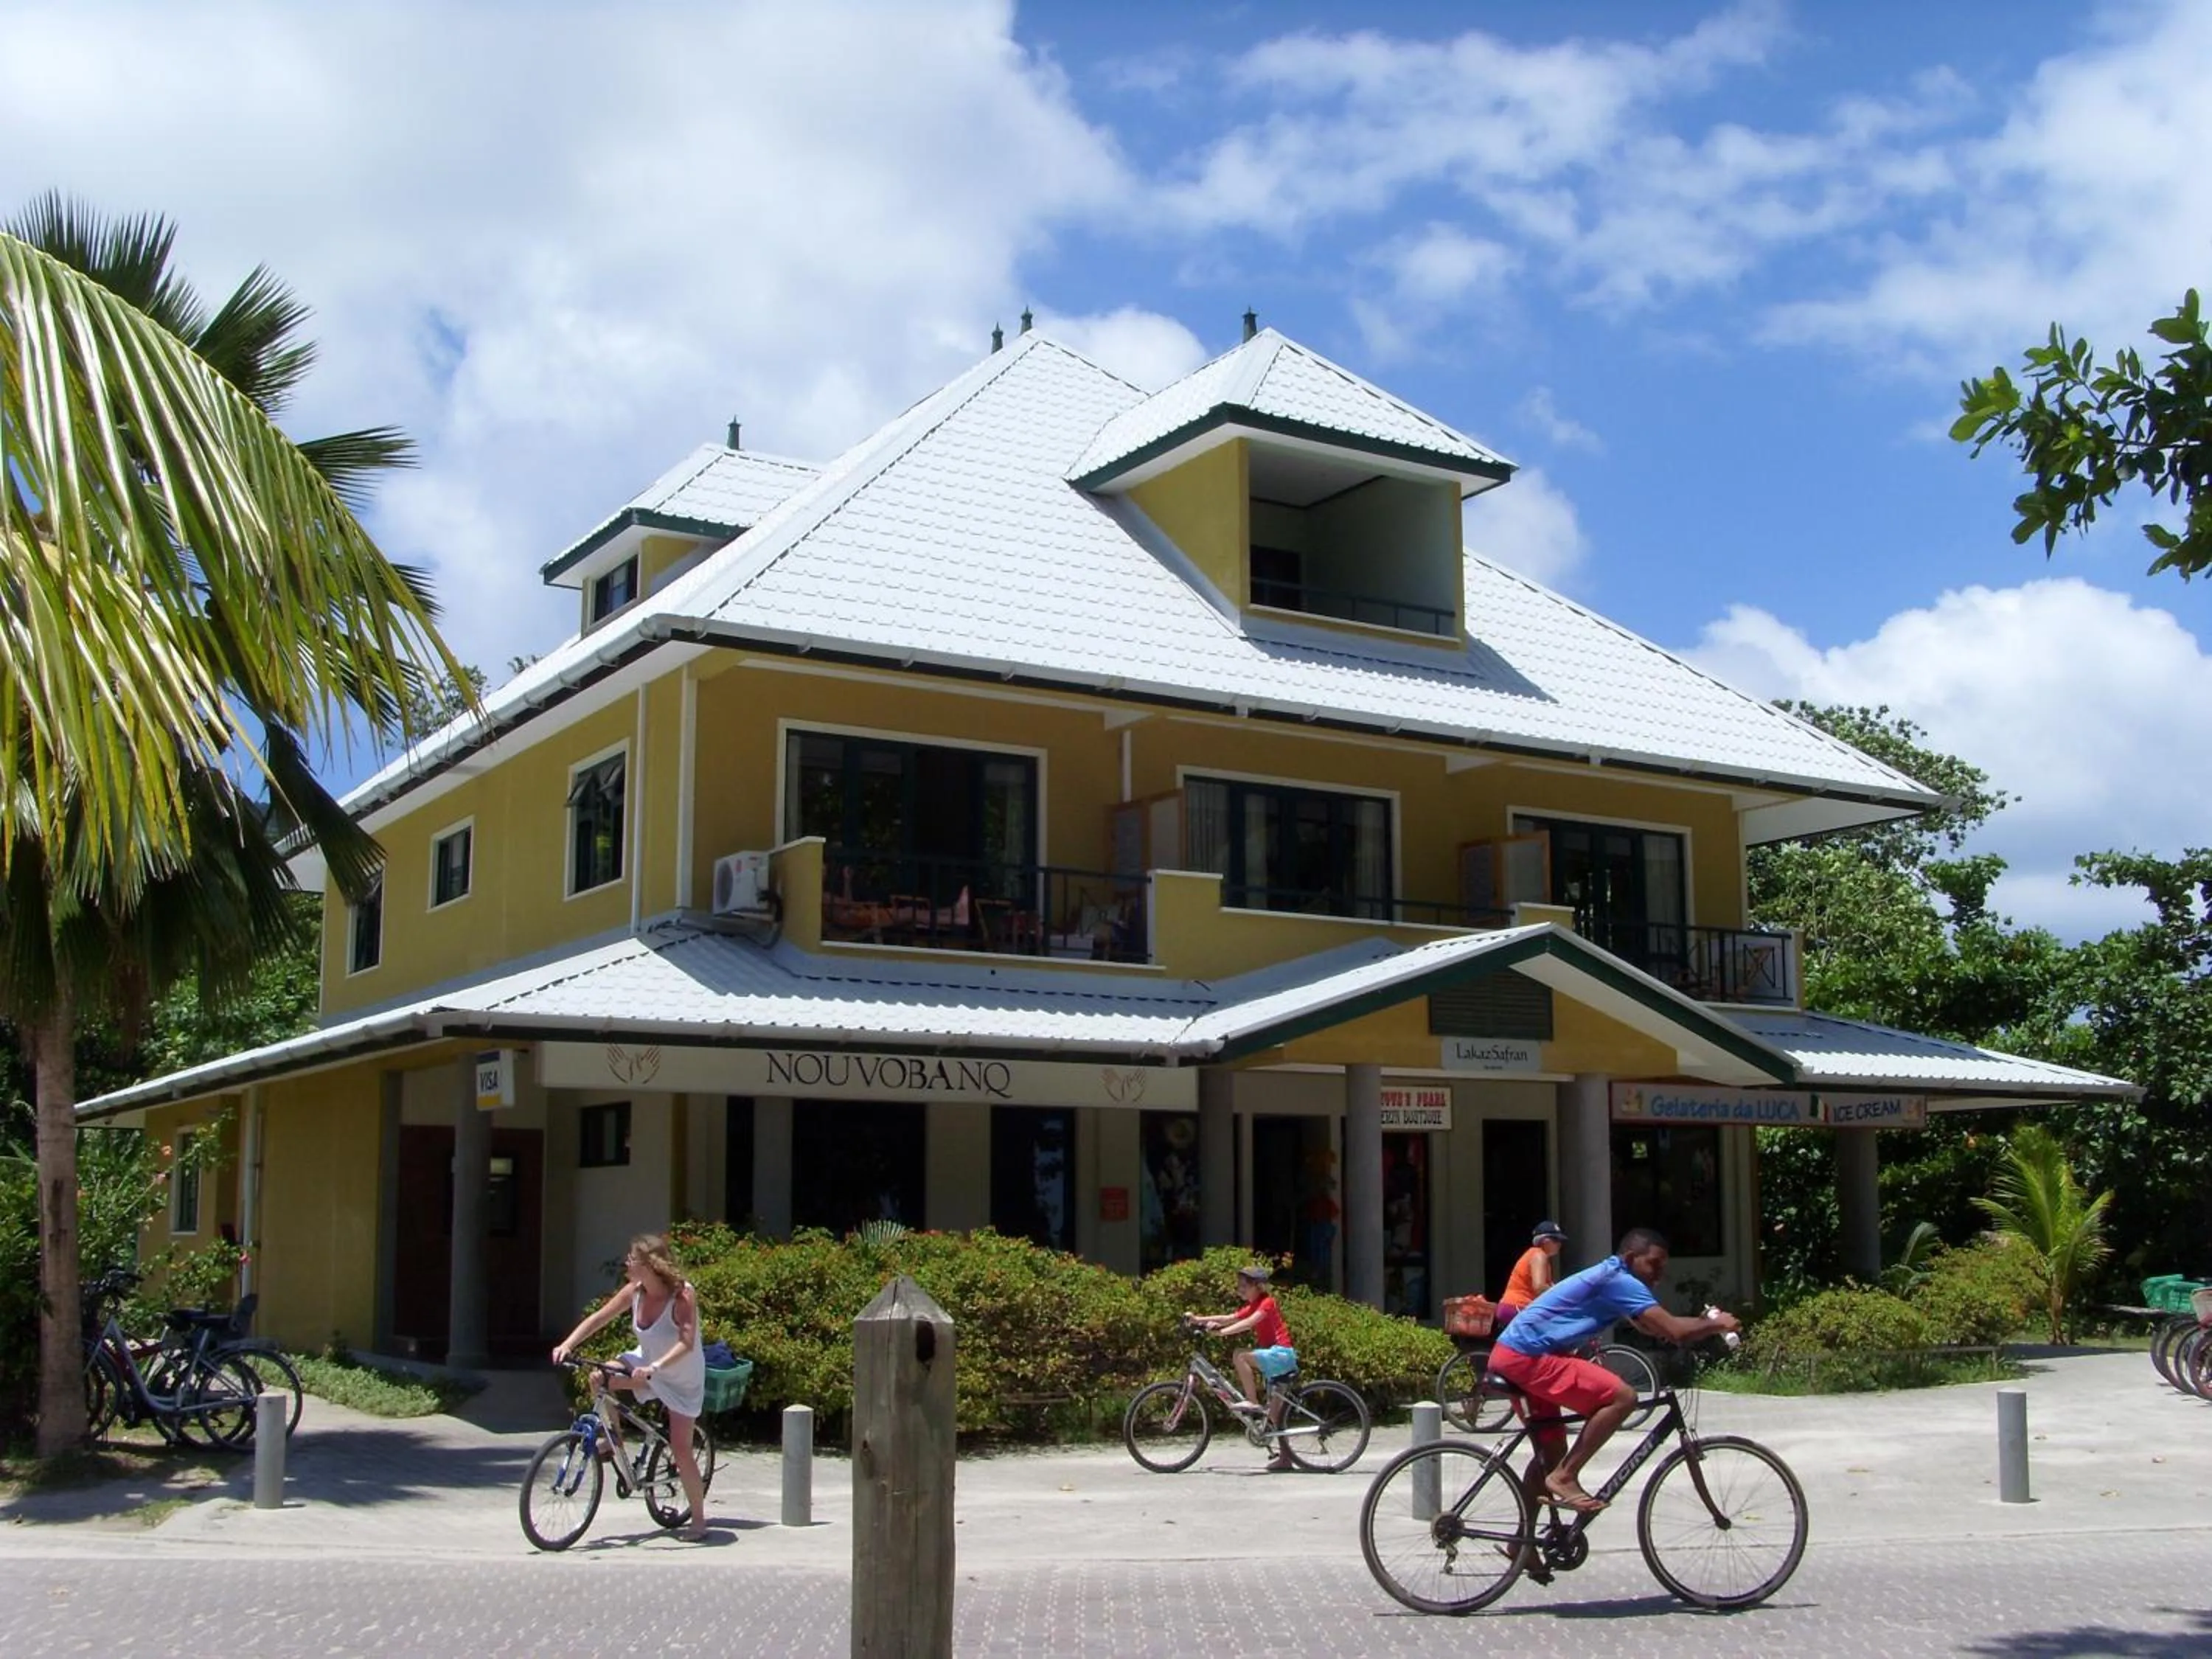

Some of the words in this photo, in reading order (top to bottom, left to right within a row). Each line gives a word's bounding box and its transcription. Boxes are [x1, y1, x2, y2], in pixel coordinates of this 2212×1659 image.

[1455, 1042, 1528, 1062] LakazSafran
[479, 1069, 499, 1093] VISA
[766, 1052, 1012, 1099] NOUVOBANQ
[1651, 1094, 1730, 1119] Gelateria
[1734, 1098, 1753, 1119] da
[1756, 1099, 1801, 1121] LUCA
[1833, 1105, 1854, 1123] ICE
[1856, 1099, 1902, 1119] CREAM
